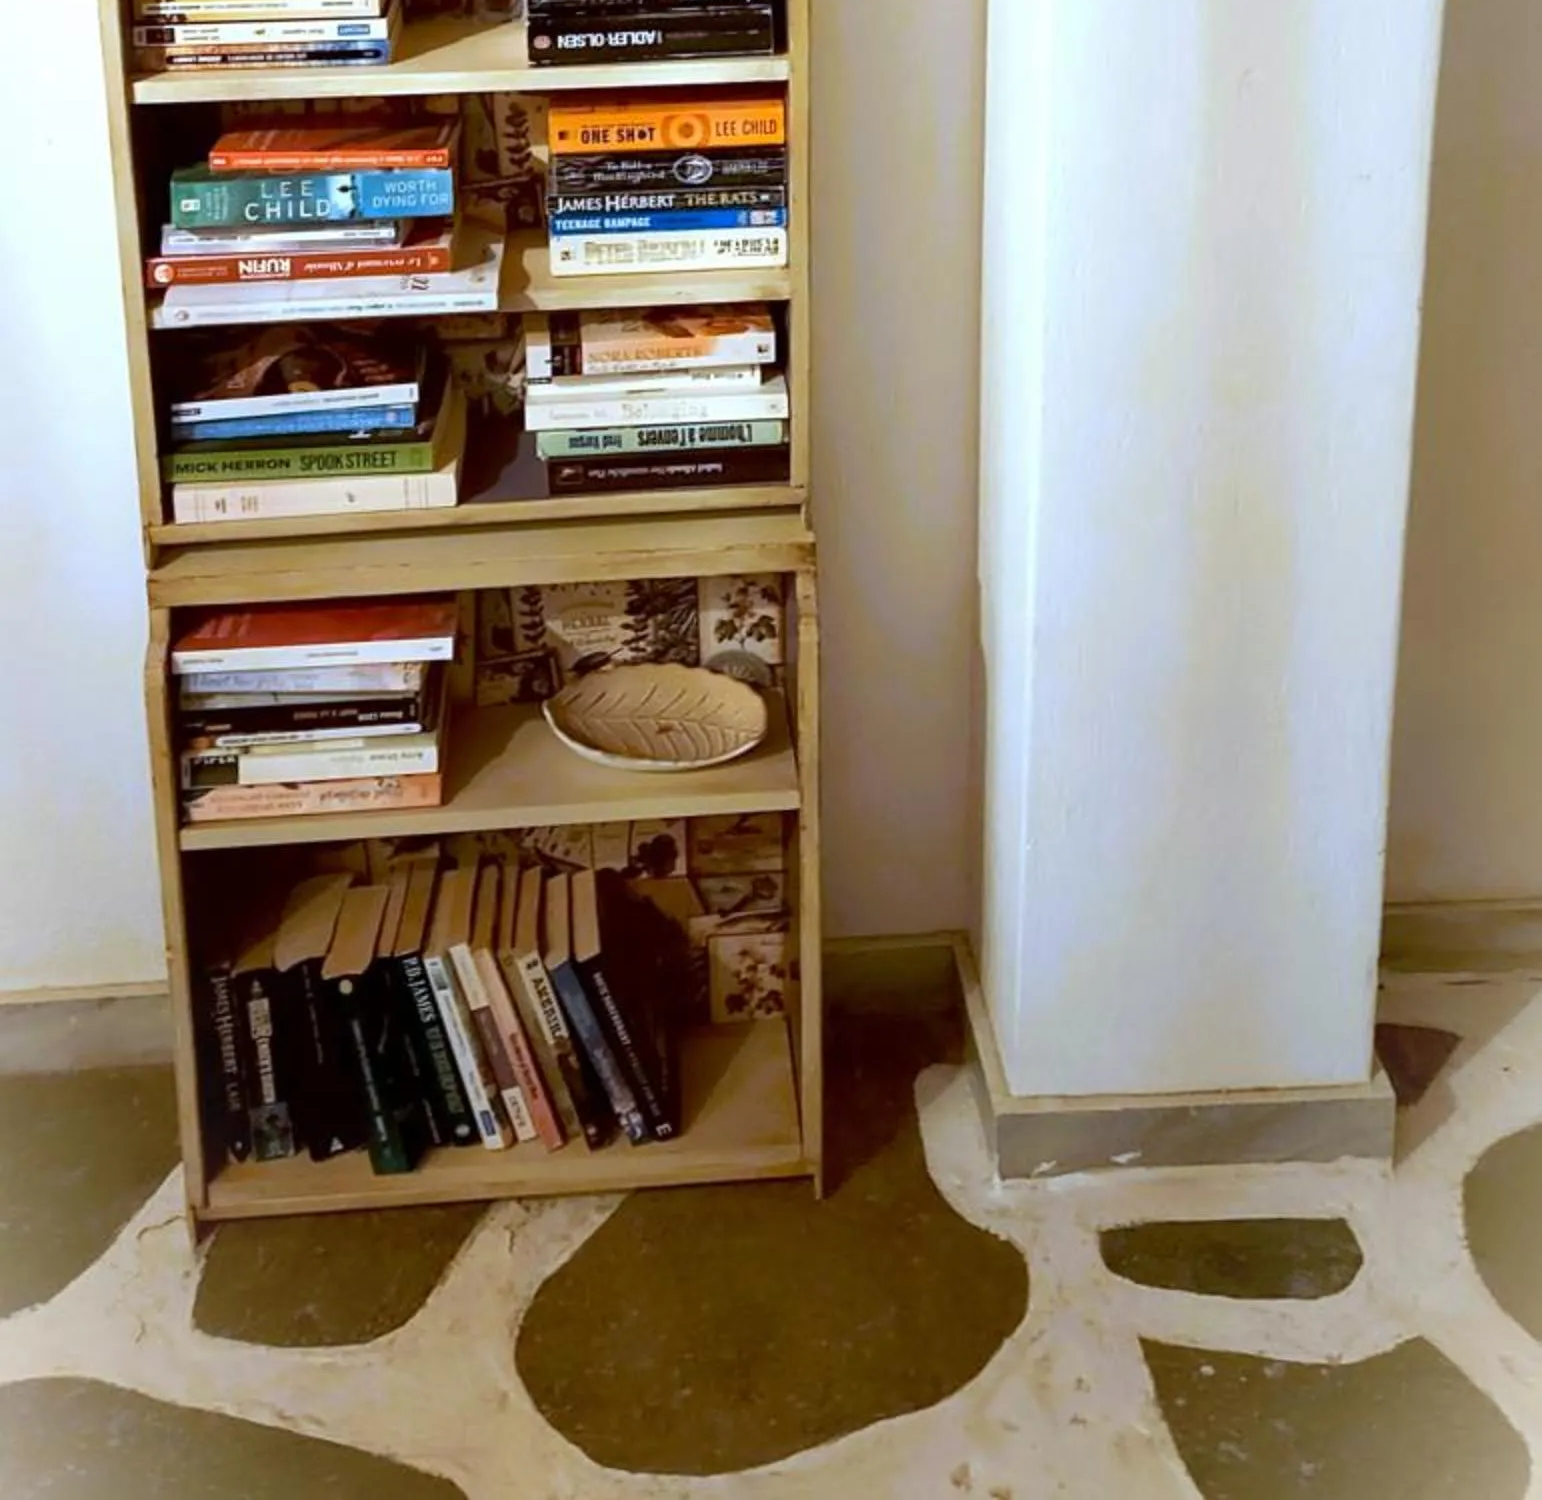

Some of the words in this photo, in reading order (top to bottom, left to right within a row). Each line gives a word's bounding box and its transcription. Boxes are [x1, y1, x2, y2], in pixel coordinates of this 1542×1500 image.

[581, 128, 610, 145] ONE
[715, 120, 737, 136] LEE
[742, 119, 778, 135] CHILD
[261, 179, 315, 199] LEE
[384, 179, 438, 195] WORTH
[372, 193, 417, 209] DYING
[419, 191, 450, 208] FOR
[555, 196, 603, 214] JAMES
[605, 194, 677, 213] HERBERT
[684, 194, 715, 208] THE
[719, 193, 758, 206] RATS
[243, 198, 332, 222] CHILD
[554, 219, 601, 231] TEENAGE
[604, 216, 652, 229] RAMPAGE
[238, 258, 291, 277] RUFIN
[174, 459, 219, 474] MICK
[221, 457, 292, 473] HERRON
[298, 452, 344, 472] SPOOK
[344, 450, 399, 469] STREET
[210, 976, 232, 1015] JAMES
[407, 980, 437, 1024] JAMES
[213, 1015, 238, 1075] HERBERT
